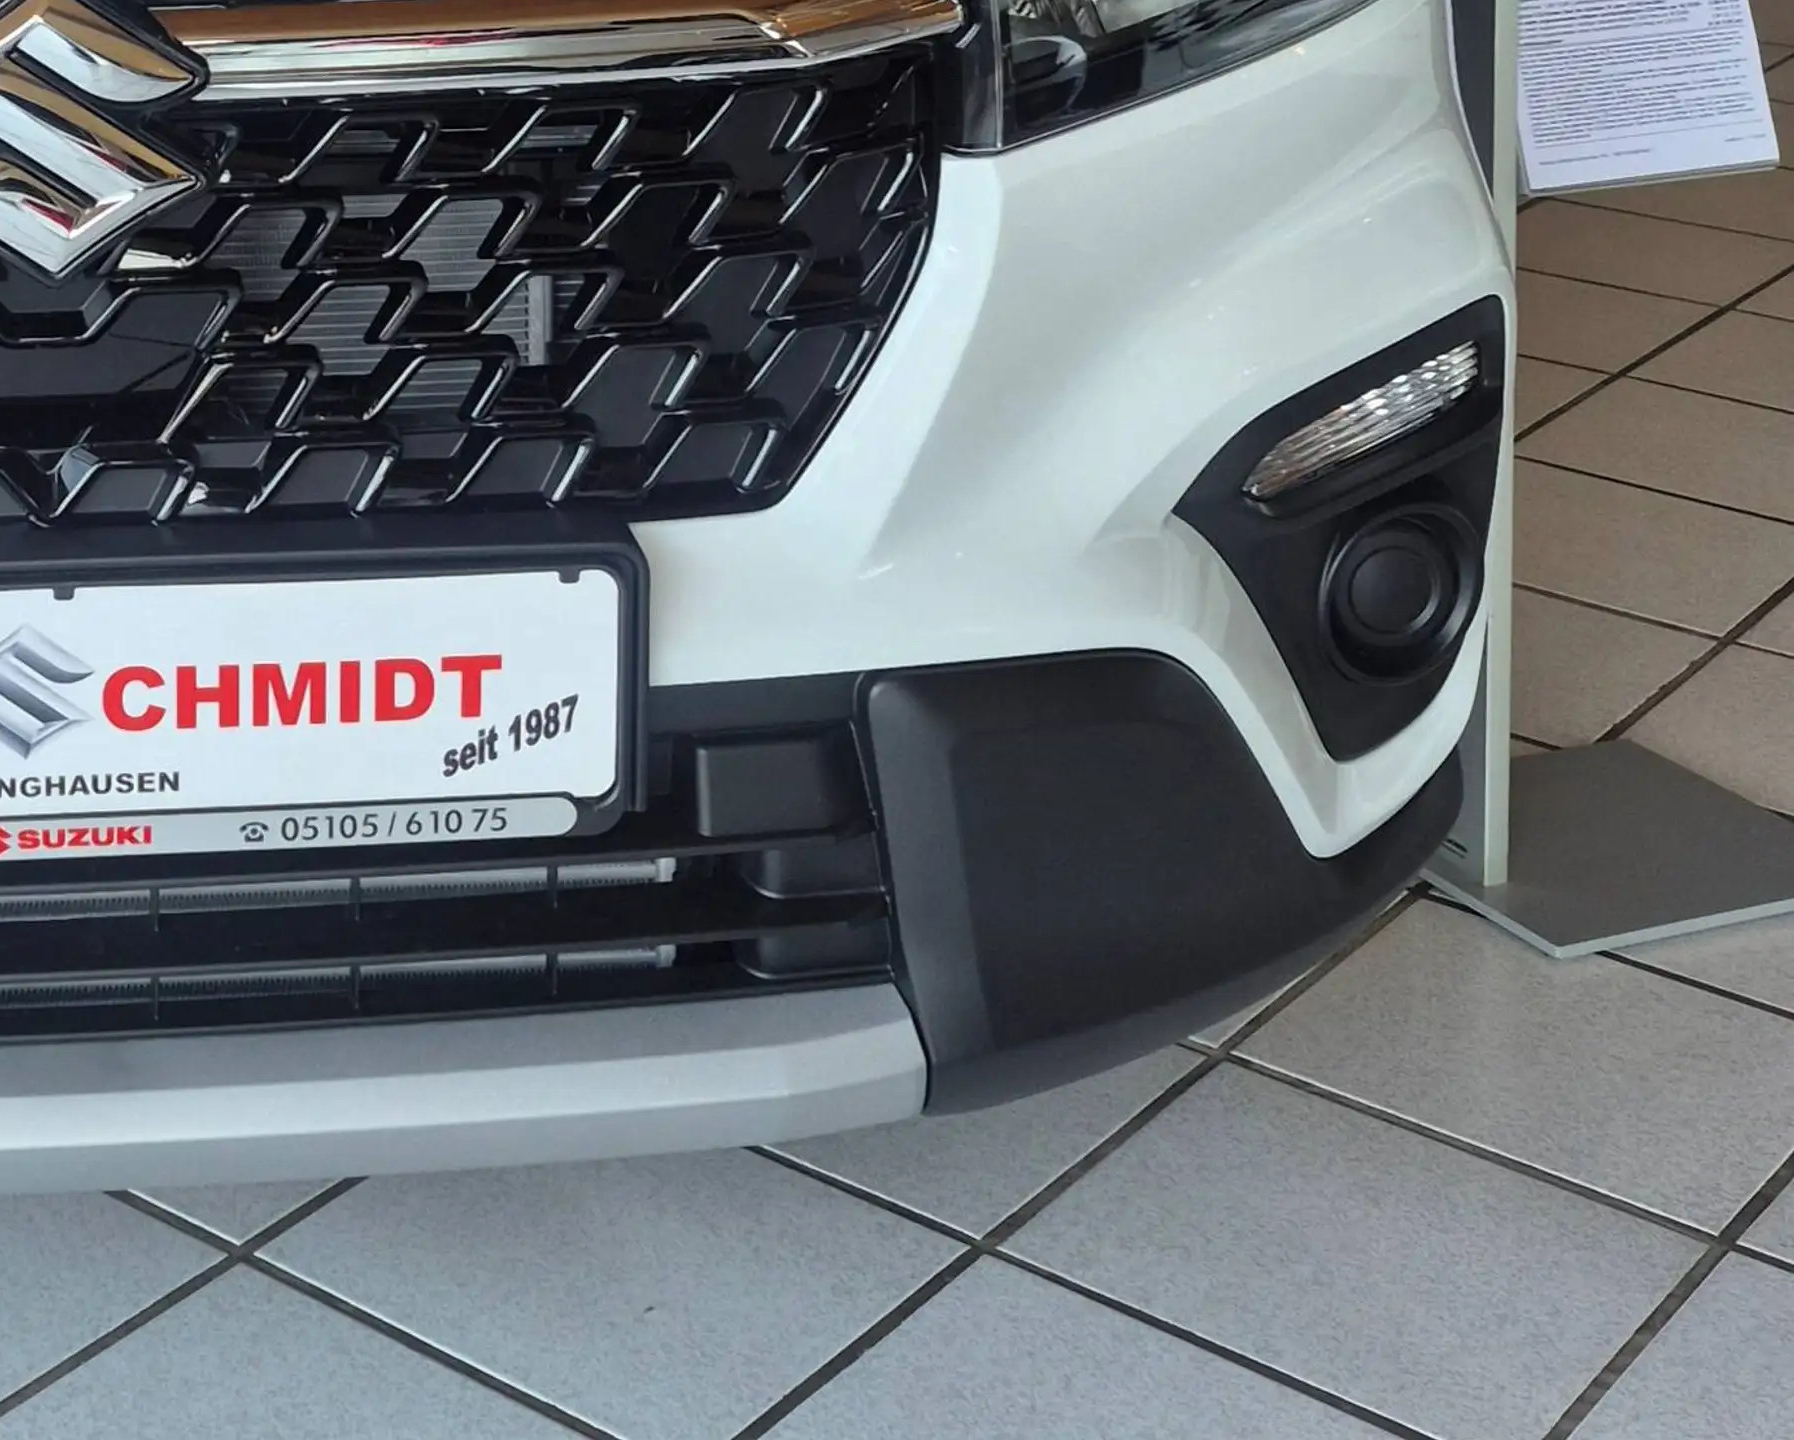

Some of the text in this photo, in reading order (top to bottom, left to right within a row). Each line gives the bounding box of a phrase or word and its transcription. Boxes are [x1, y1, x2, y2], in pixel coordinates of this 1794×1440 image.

[443, 694, 579, 777] seit 1987
[17, 826, 153, 851] SUZUKI
[280, 814, 379, 841] 05105
